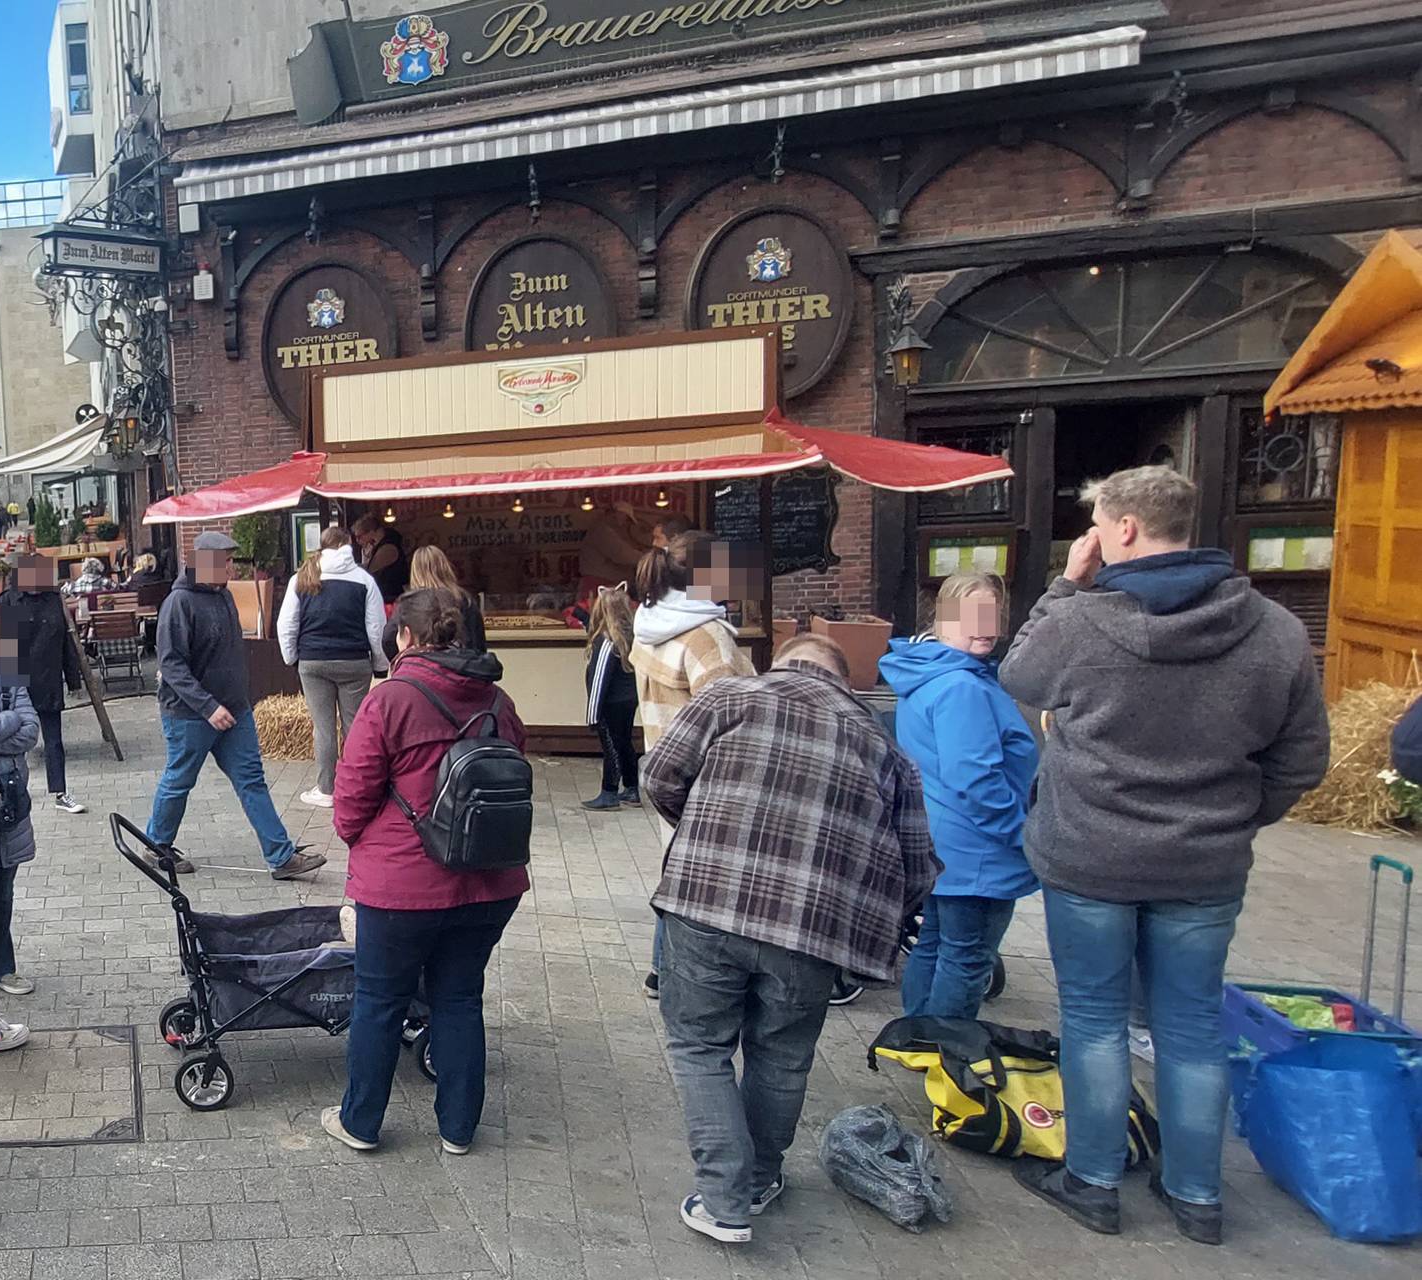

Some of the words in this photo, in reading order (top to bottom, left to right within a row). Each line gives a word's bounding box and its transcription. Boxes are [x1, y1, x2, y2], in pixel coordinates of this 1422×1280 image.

[90, 244, 119, 262] Alten
[509, 272, 570, 301] Zum
[727, 286, 808, 301] DORTMUNDER
[707, 294, 832, 328] THIER
[496, 302, 587, 341] Alten
[293, 331, 360, 345] DORTMUNDER
[277, 338, 380, 369] THIER
[465, 515, 509, 532] Max
[518, 514, 573, 530] Arens
[309, 992, 346, 1002] FUXTEC
